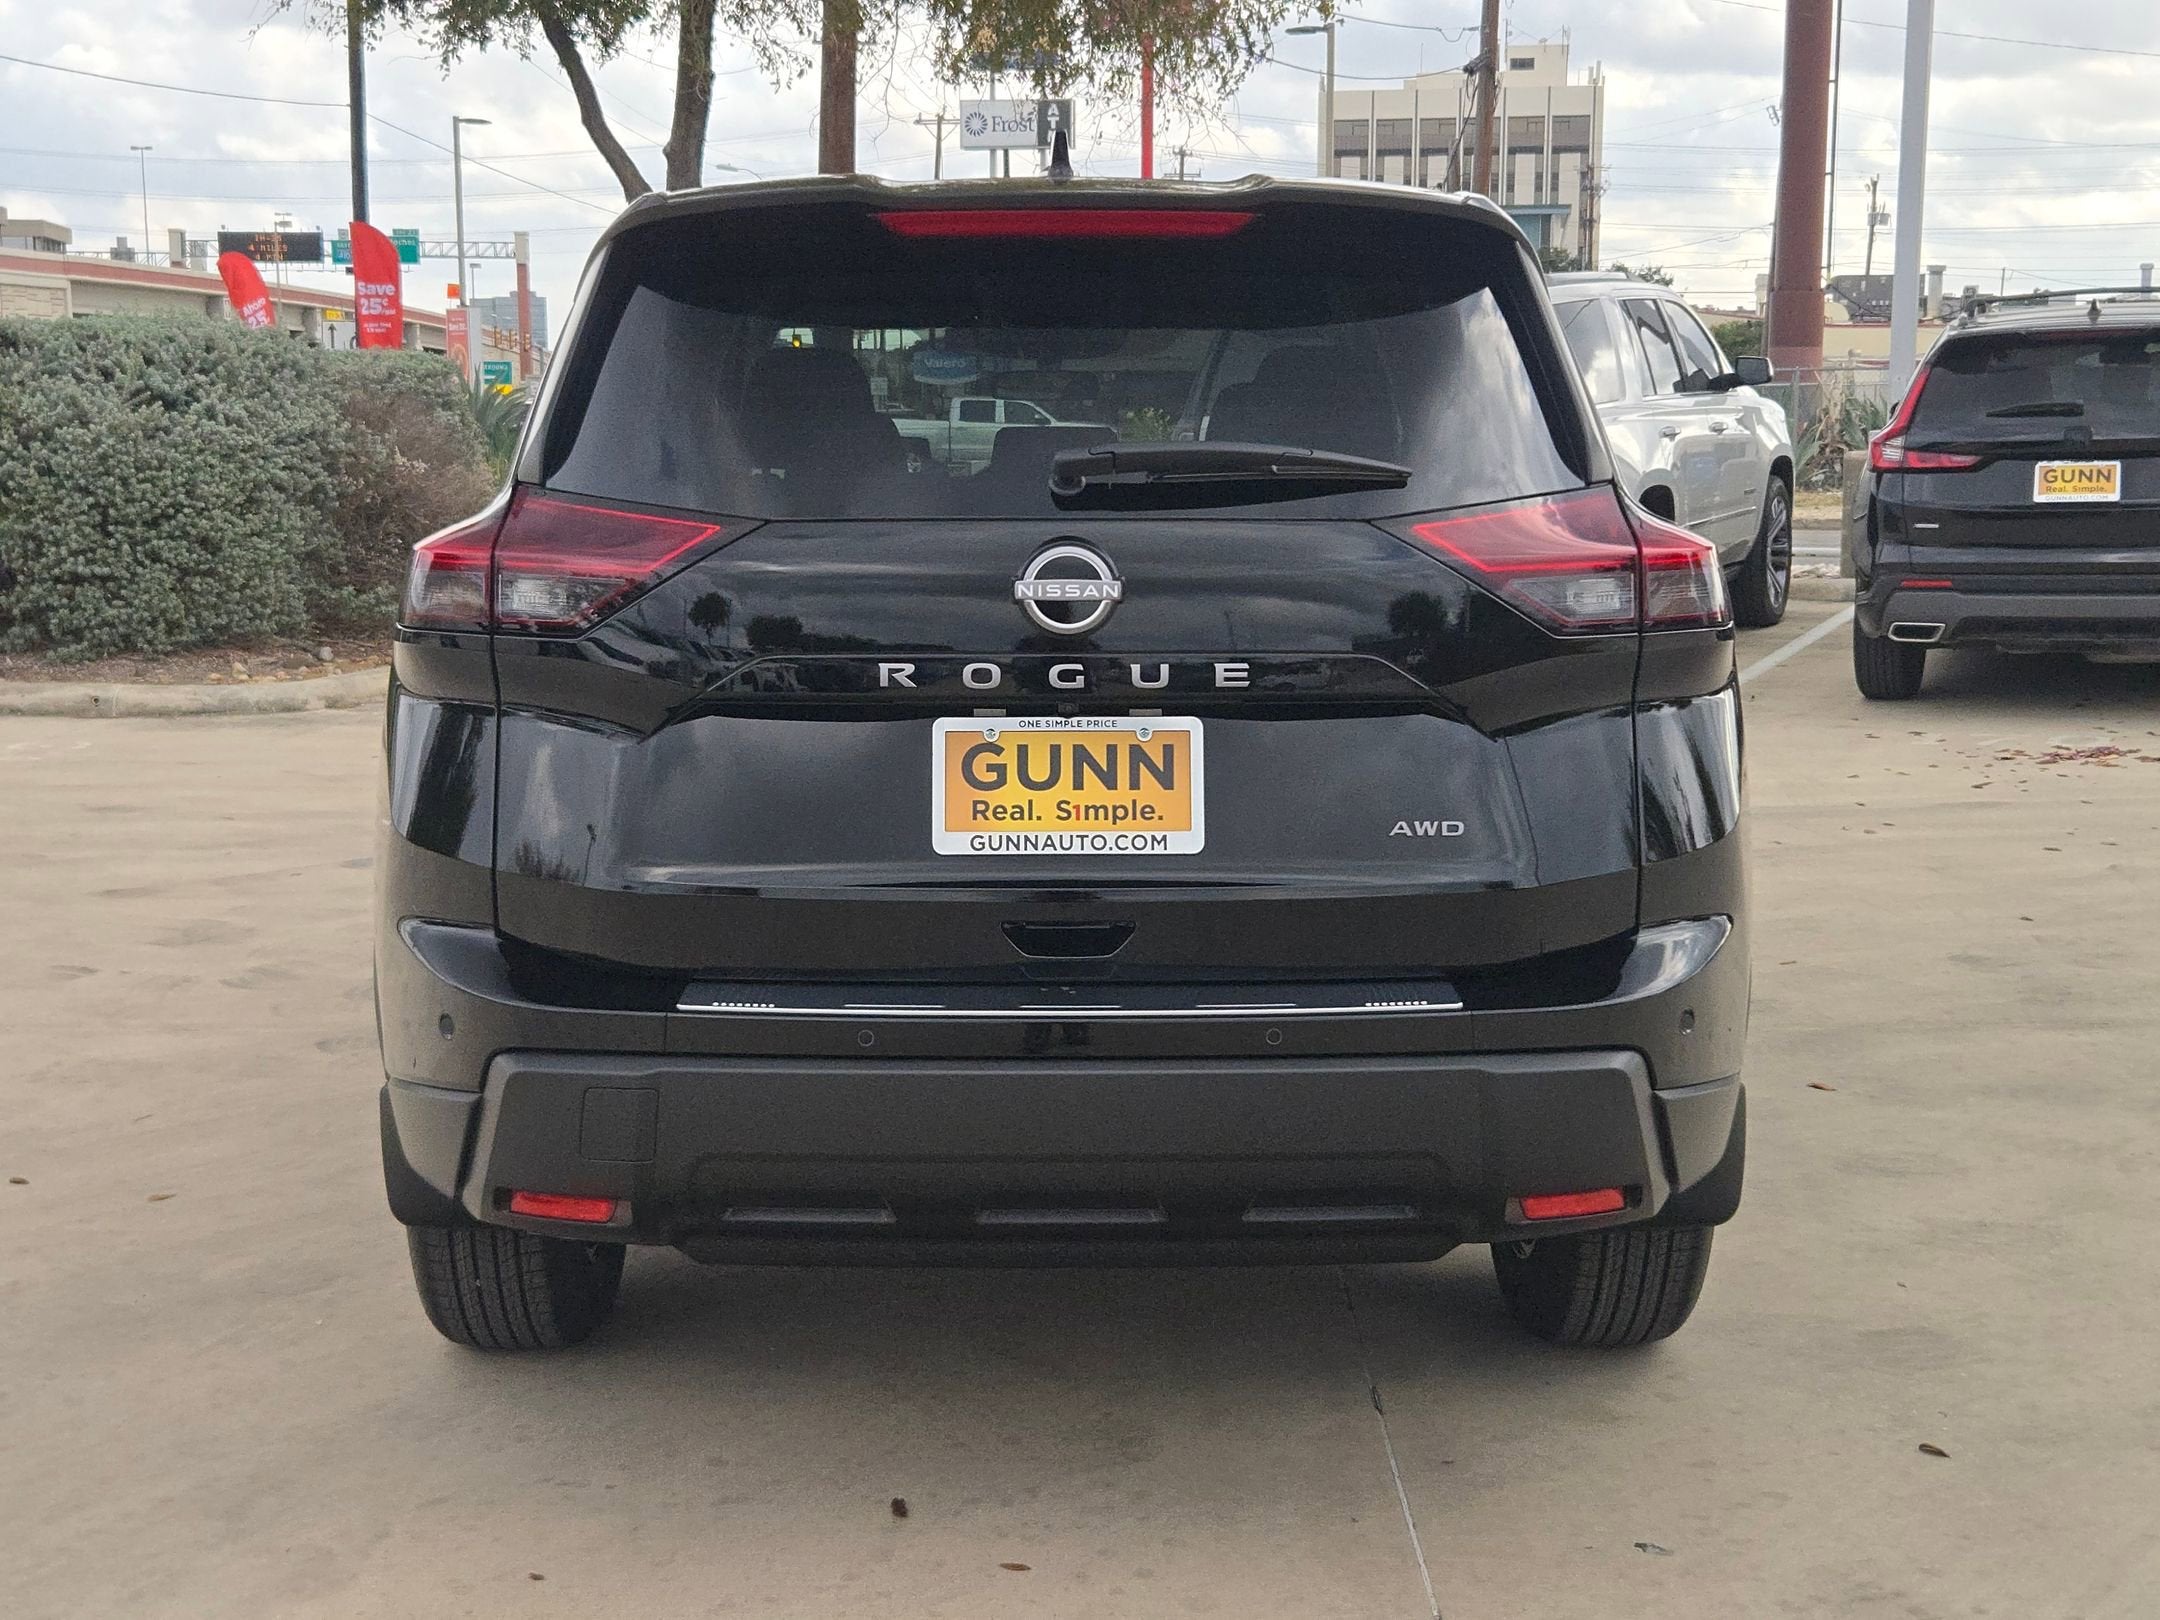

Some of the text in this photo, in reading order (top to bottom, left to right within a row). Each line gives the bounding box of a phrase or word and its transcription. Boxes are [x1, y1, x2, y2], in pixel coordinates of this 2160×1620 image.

[992, 115, 1035, 132] Frost
[357, 282, 395, 295] Save
[2043, 468, 2112, 483] GUNN
[2046, 485, 2067, 493] Real.
[1017, 584, 1119, 598] NISSAN
[878, 662, 1251, 690] ROGUE
[1018, 719, 1118, 728] ONE SIMPLE PRICE
[961, 742, 1175, 791] GUNN
[971, 799, 1042, 821] Real.
[1388, 820, 1465, 837] AWD
[970, 834, 1168, 851] GUNNAUTO.COM
